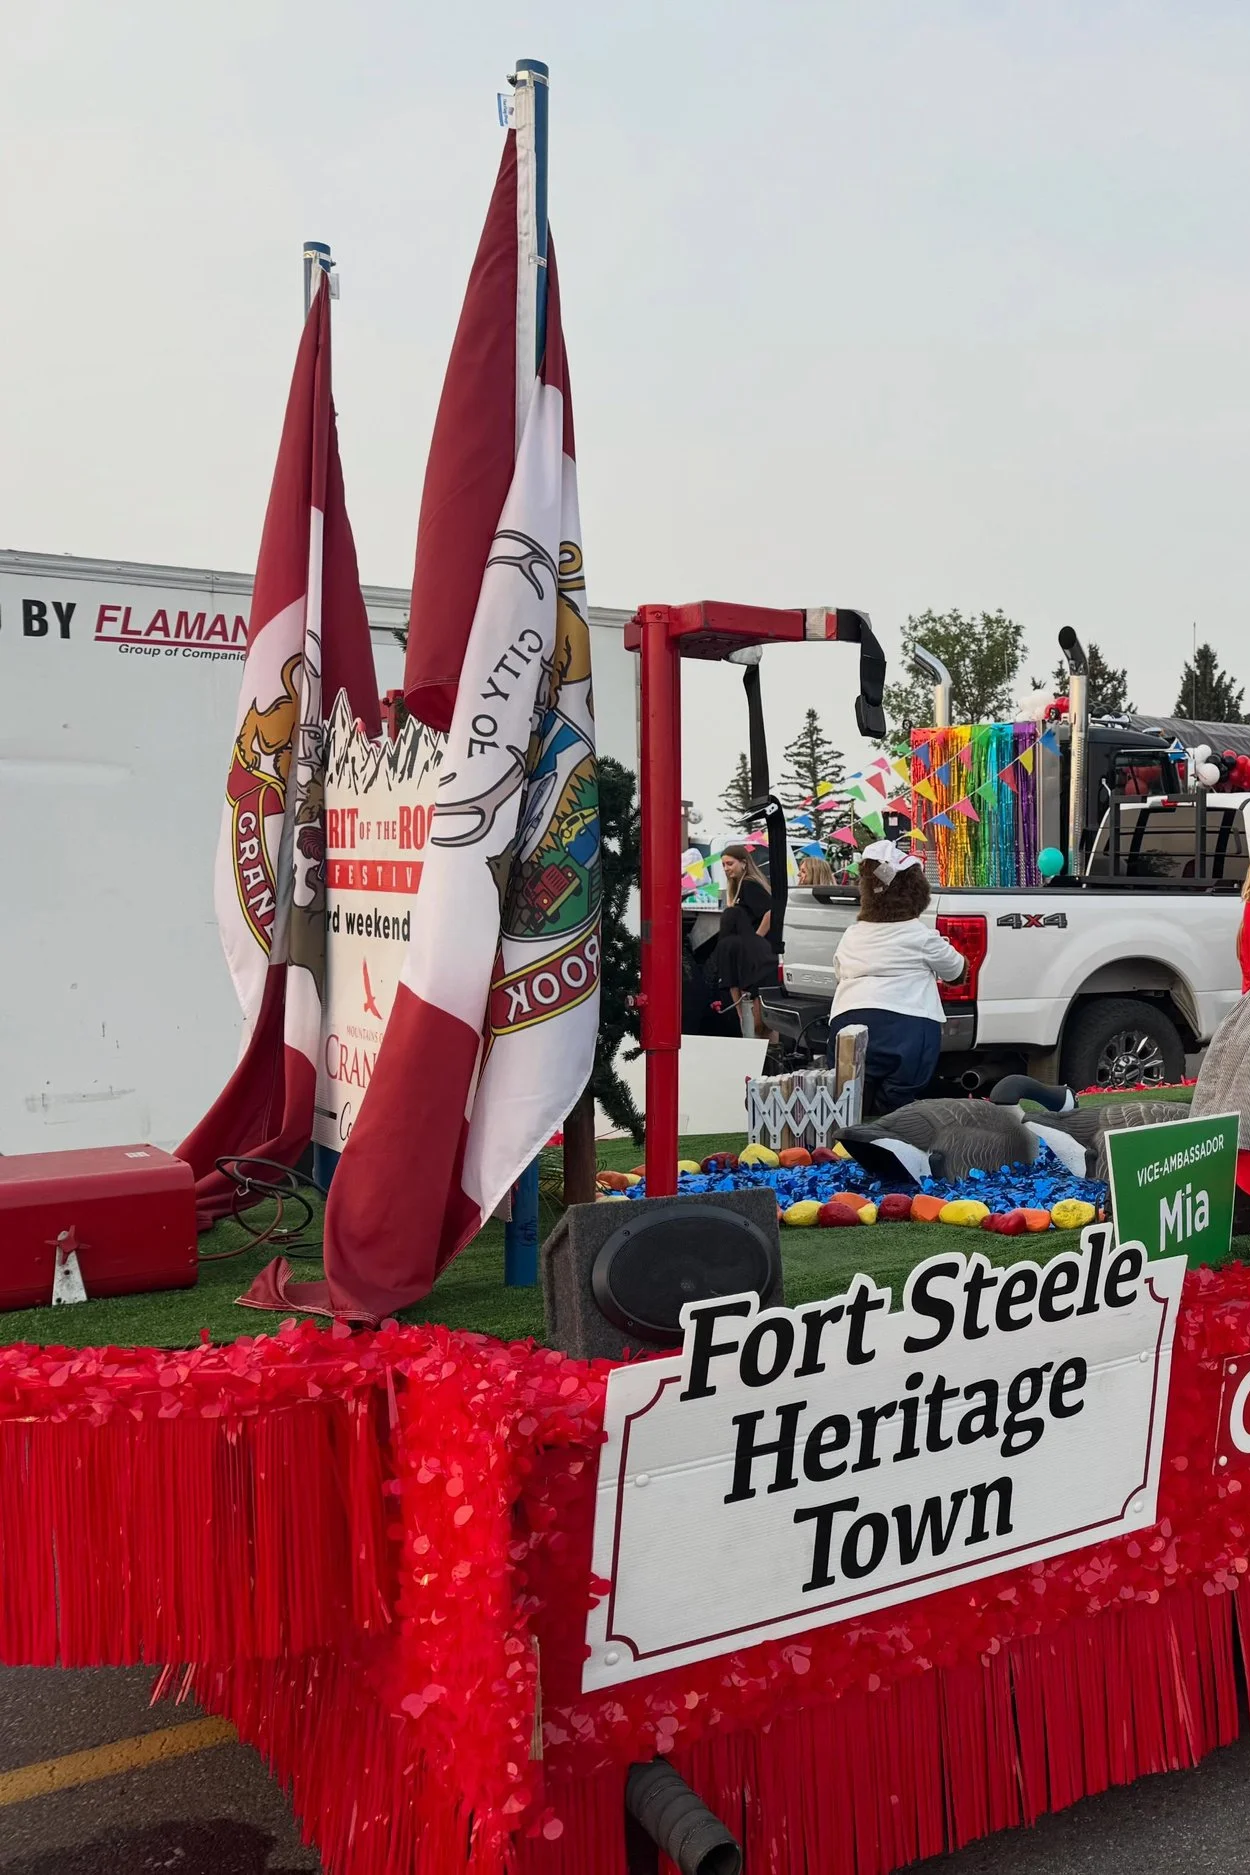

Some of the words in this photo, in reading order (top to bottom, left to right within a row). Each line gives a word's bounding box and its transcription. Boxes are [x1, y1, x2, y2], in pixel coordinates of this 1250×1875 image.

[22, 598, 77, 640] BY
[95, 604, 249, 643] FLAMAN
[118, 643, 161, 658] Group
[164, 647, 179, 657] of
[327, 808, 359, 849] RIT
[360, 821, 371, 840] OF
[376, 820, 397, 840] THE
[335, 864, 413, 888] FESTIV
[346, 907, 411, 942] weekend
[1136, 1133, 1224, 1188] VICE-AMBASSADOR
[1159, 1182, 1210, 1253] Mia
[680, 1284, 885, 1402] Fort
[903, 1231, 1143, 1355] Steele
[724, 1355, 1087, 1505] Heritage
[793, 1475, 1014, 1593] Town
